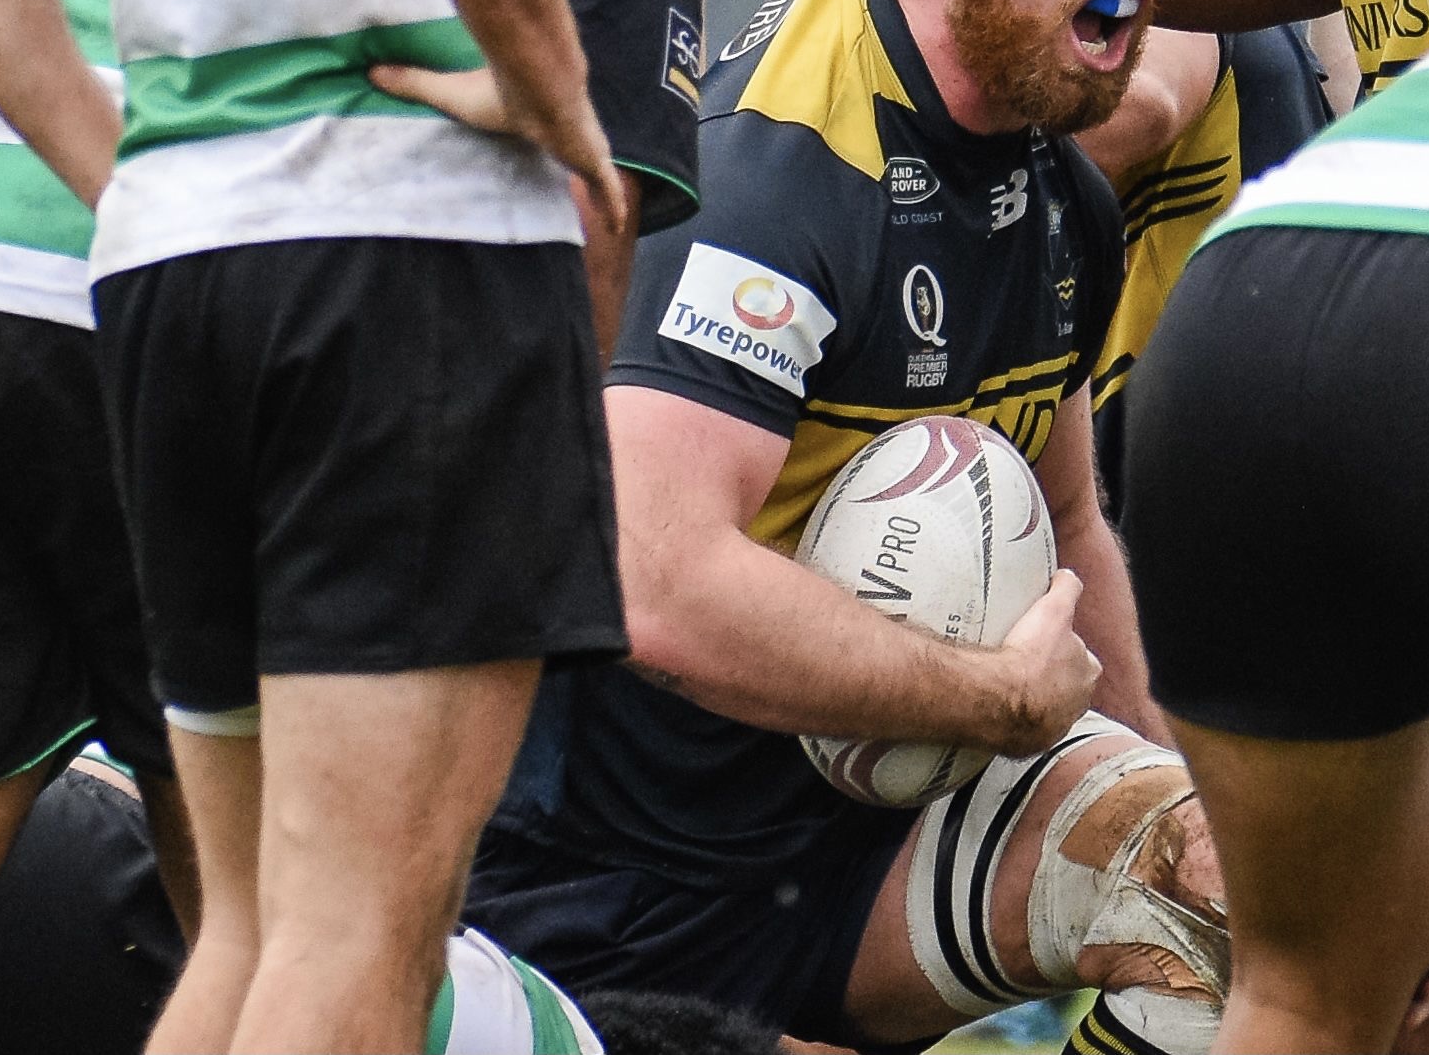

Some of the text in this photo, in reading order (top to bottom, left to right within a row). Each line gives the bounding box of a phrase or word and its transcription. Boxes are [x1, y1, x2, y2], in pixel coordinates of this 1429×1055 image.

[890, 166, 913, 179] AND
[891, 179, 927, 192] ROVER
[910, 211, 943, 224] COAST
[902, 264, 947, 347] Q
[674, 301, 803, 382] Tyrepowe
[907, 361, 948, 374] PREMIER
[906, 372, 948, 388] RUGBY
[876, 516, 921, 573] PRO
